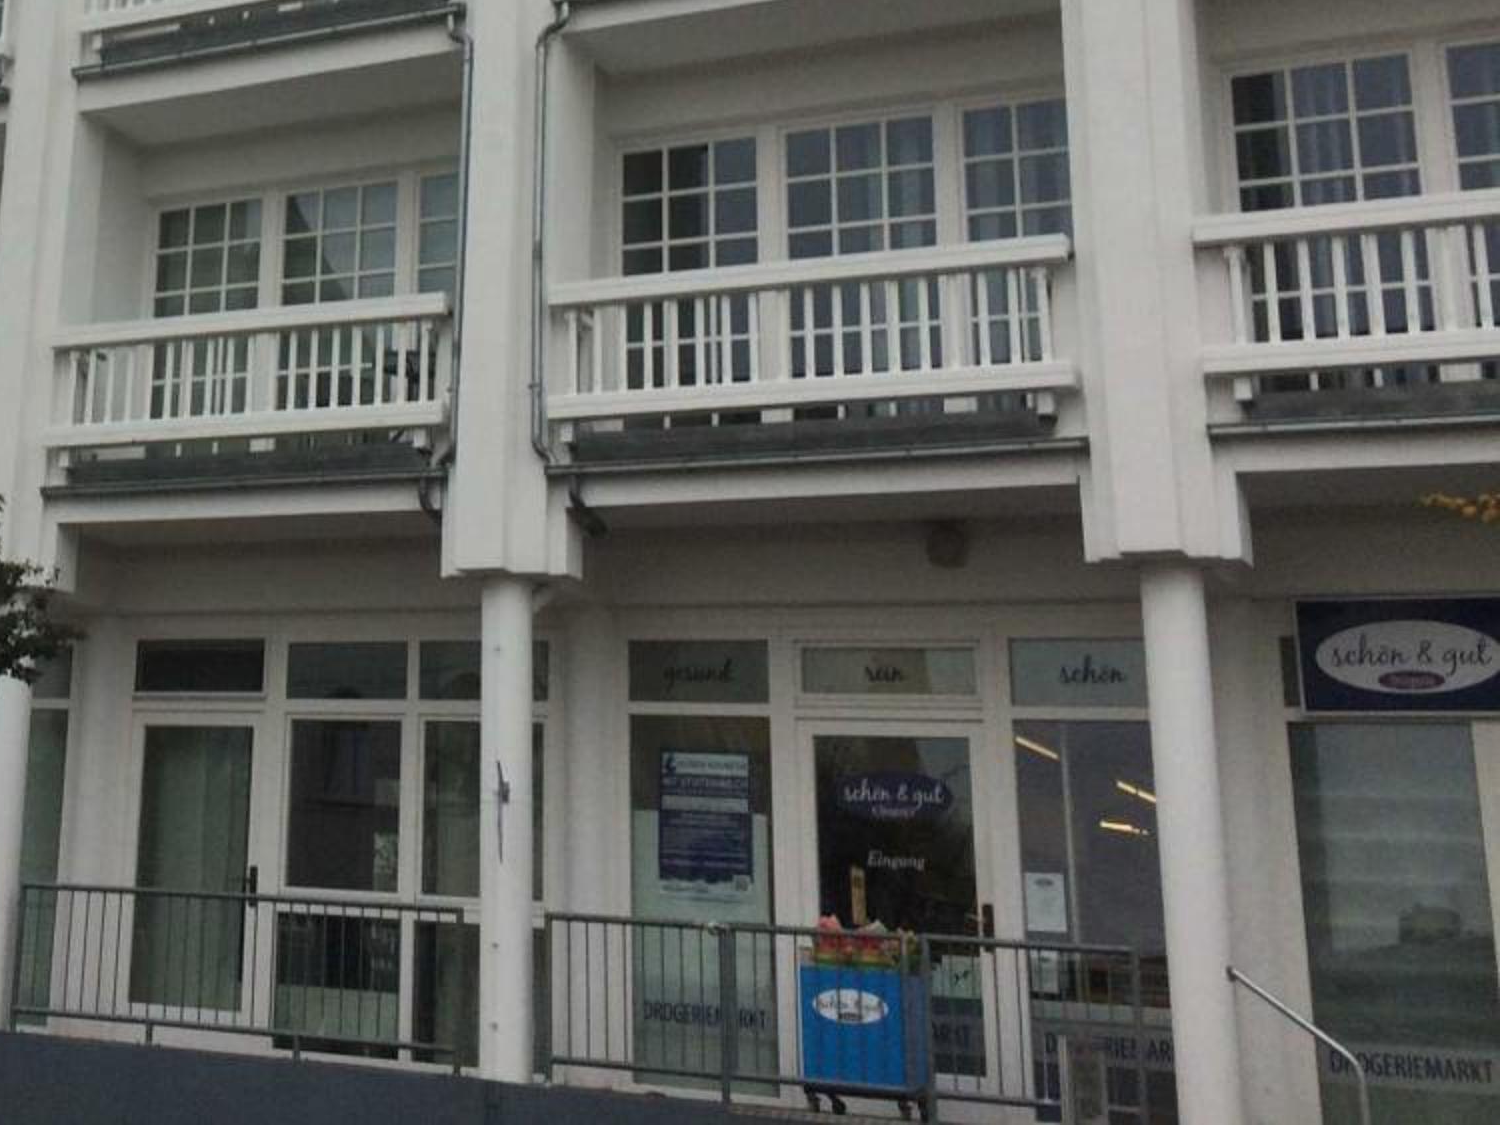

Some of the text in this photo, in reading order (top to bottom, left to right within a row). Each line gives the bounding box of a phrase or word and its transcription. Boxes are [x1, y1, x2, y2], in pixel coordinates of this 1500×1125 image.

[1332, 633, 1493, 676] schön & gut
